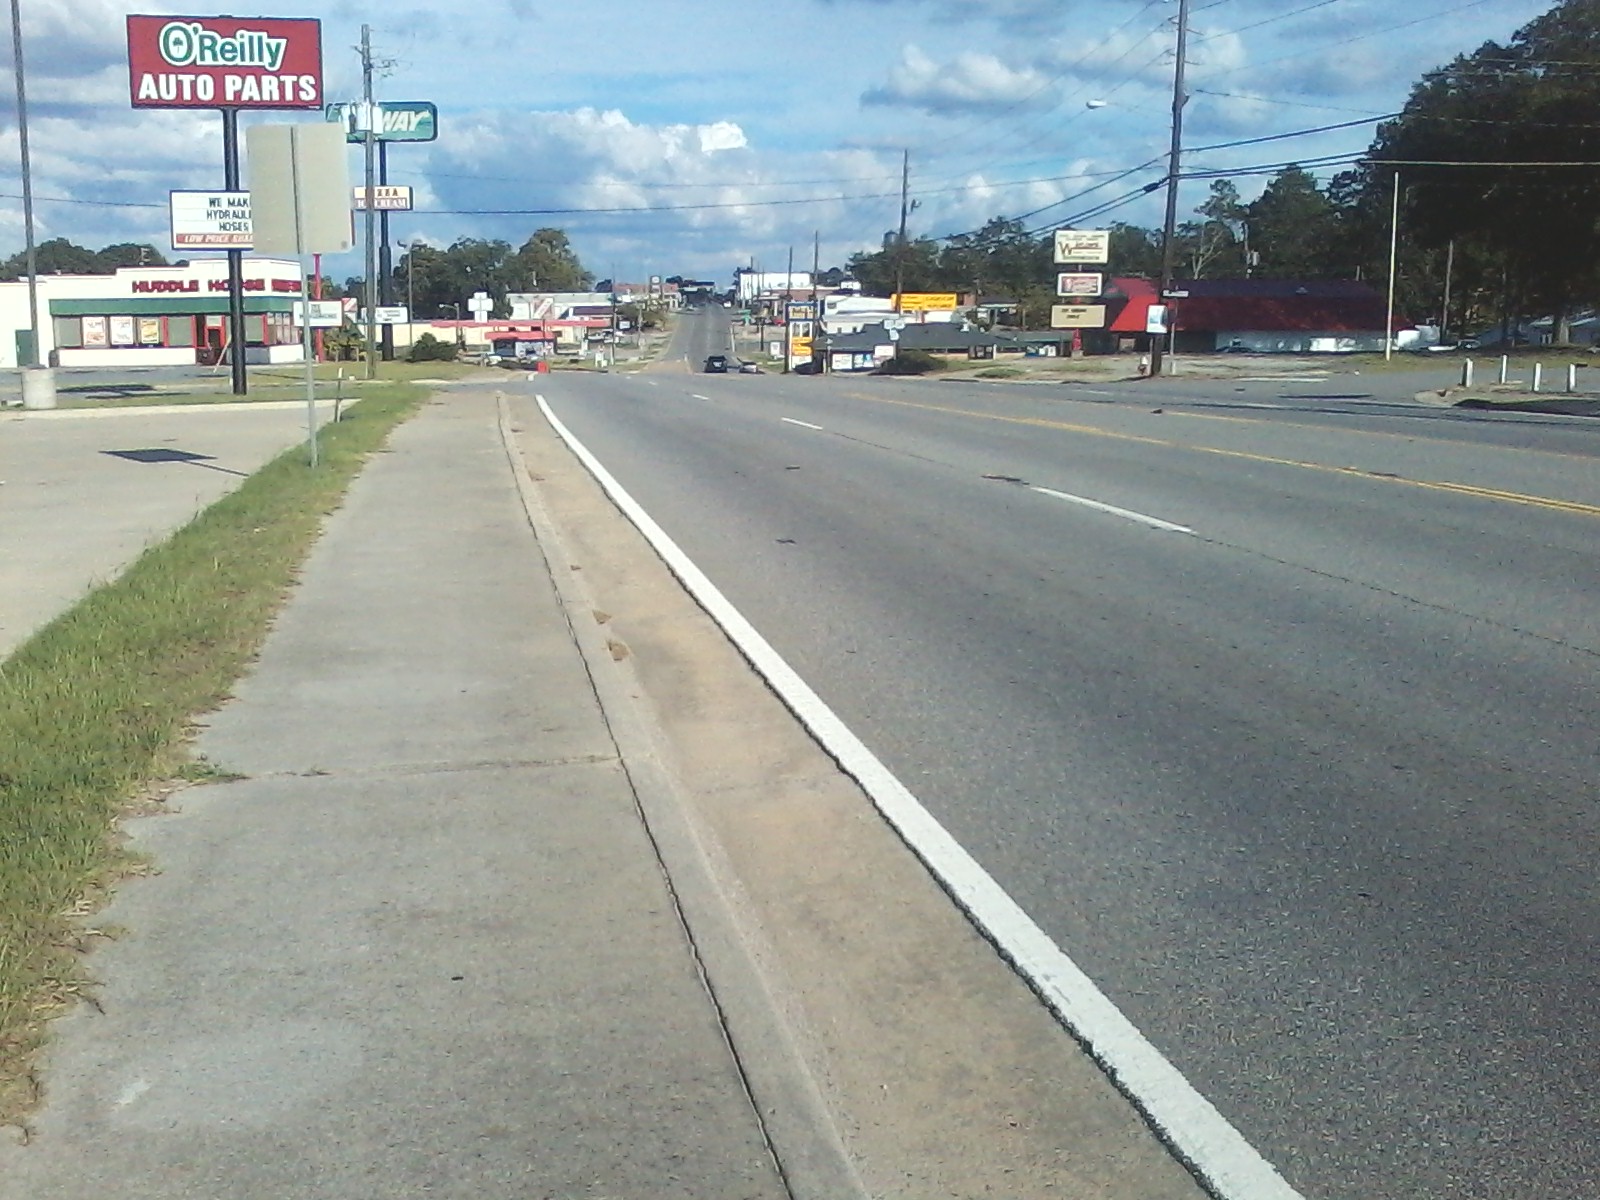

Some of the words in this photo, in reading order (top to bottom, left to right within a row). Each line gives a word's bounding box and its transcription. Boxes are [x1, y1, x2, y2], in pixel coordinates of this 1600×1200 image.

[160, 22, 285, 70] O'Reilly
[138, 74, 215, 101] AUTO
[224, 75, 317, 102] PARTS
[227, 198, 249, 208] MAK
[206, 210, 252, 220] HYDRAULI
[131, 279, 199, 293] HUDDLE
[208, 278, 266, 292] HOSE
